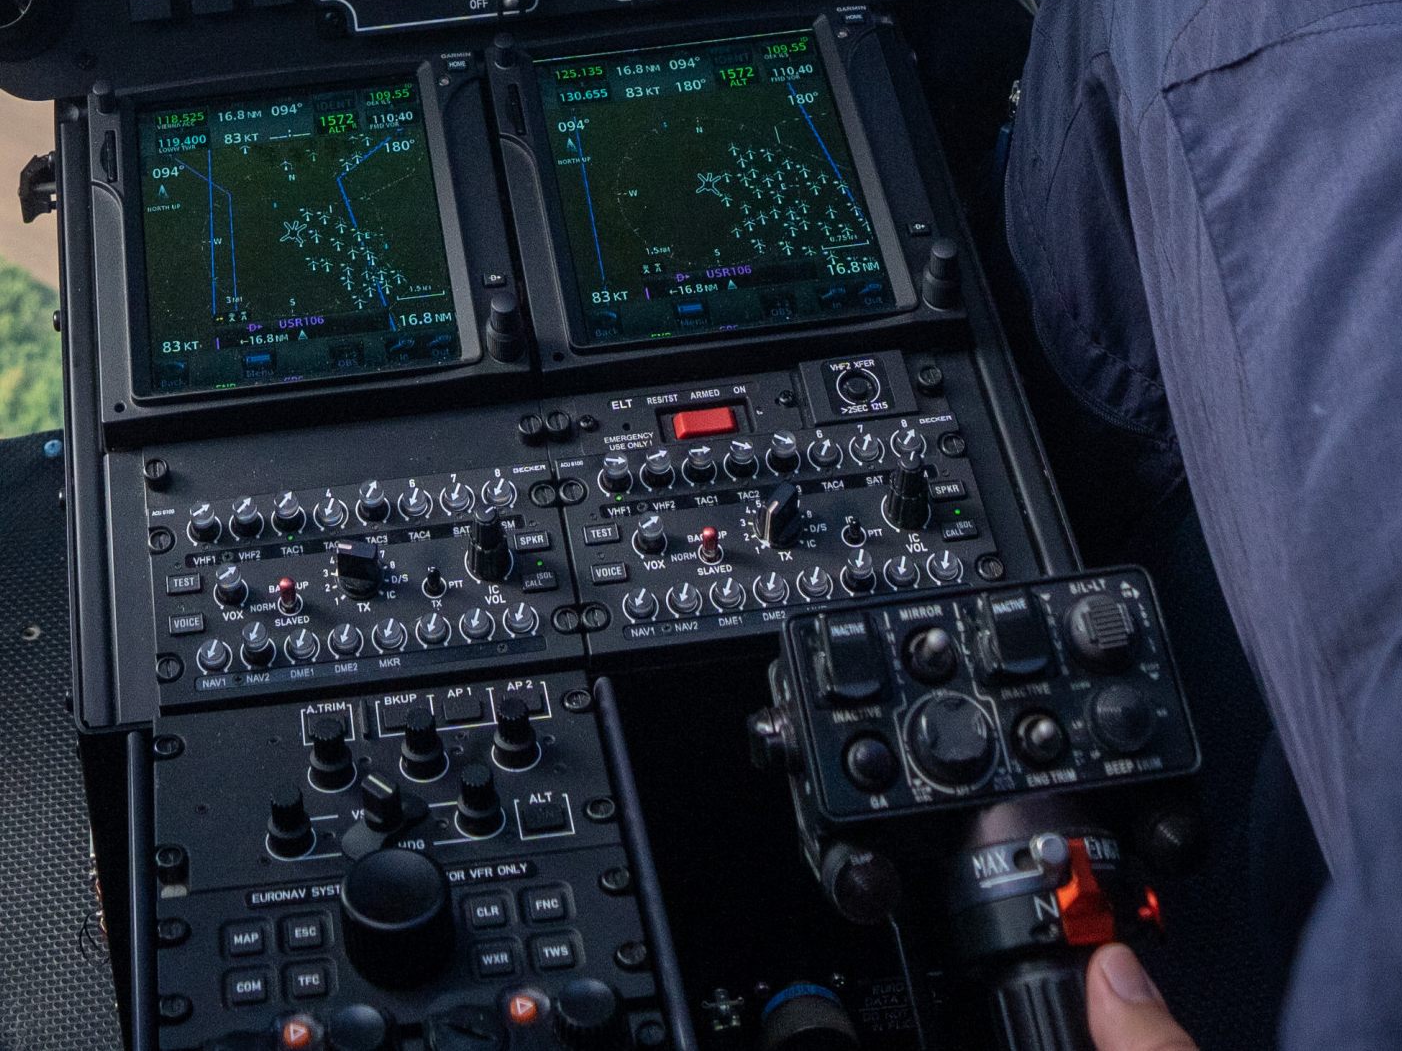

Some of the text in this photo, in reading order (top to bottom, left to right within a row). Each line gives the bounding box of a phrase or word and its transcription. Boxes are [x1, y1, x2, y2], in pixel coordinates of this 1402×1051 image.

[616, 64, 644, 76] 16.8
[719, 67, 755, 80] 1572
[646, 86, 660, 96] KT
[706, 265, 752, 279] USR106
[279, 315, 325, 329] USR106
[830, 359, 875, 371] VHF2 XFER
[647, 386, 746, 405] RES/TST ARMED ON
[611, 399, 632, 410] ELT
[604, 432, 654, 443] EMERGENCY
[609, 440, 648, 451] USE ONLY
[935, 484, 960, 495] SPKR
[591, 528, 612, 538] TEST
[520, 535, 544, 546] SPKR
[644, 560, 665, 570] VOX
[697, 564, 732, 576] SLAVED
[596, 567, 622, 578] VOICE
[174, 577, 194, 587] TEST
[222, 610, 244, 622] VOX
[900, 603, 943, 620] MIRROR
[174, 617, 200, 628] VOICE
[275, 615, 309, 627] SLAVED
[631, 627, 655, 638] NAV1
[675, 622, 698, 633] NAV2
[290, 668, 315, 678] DME1
[202, 678, 226, 688] NAV1
[305, 680, 533, 715] A.TRIM BKUP AP 1 AP 2
[529, 792, 553, 806] ALT
[470, 862, 528, 880] VFR ONLY
[972, 853, 1010, 879] MAX
[535, 897, 559, 912] FNC
[476, 904, 500, 919] CLR
[234, 931, 259, 947] MAP
